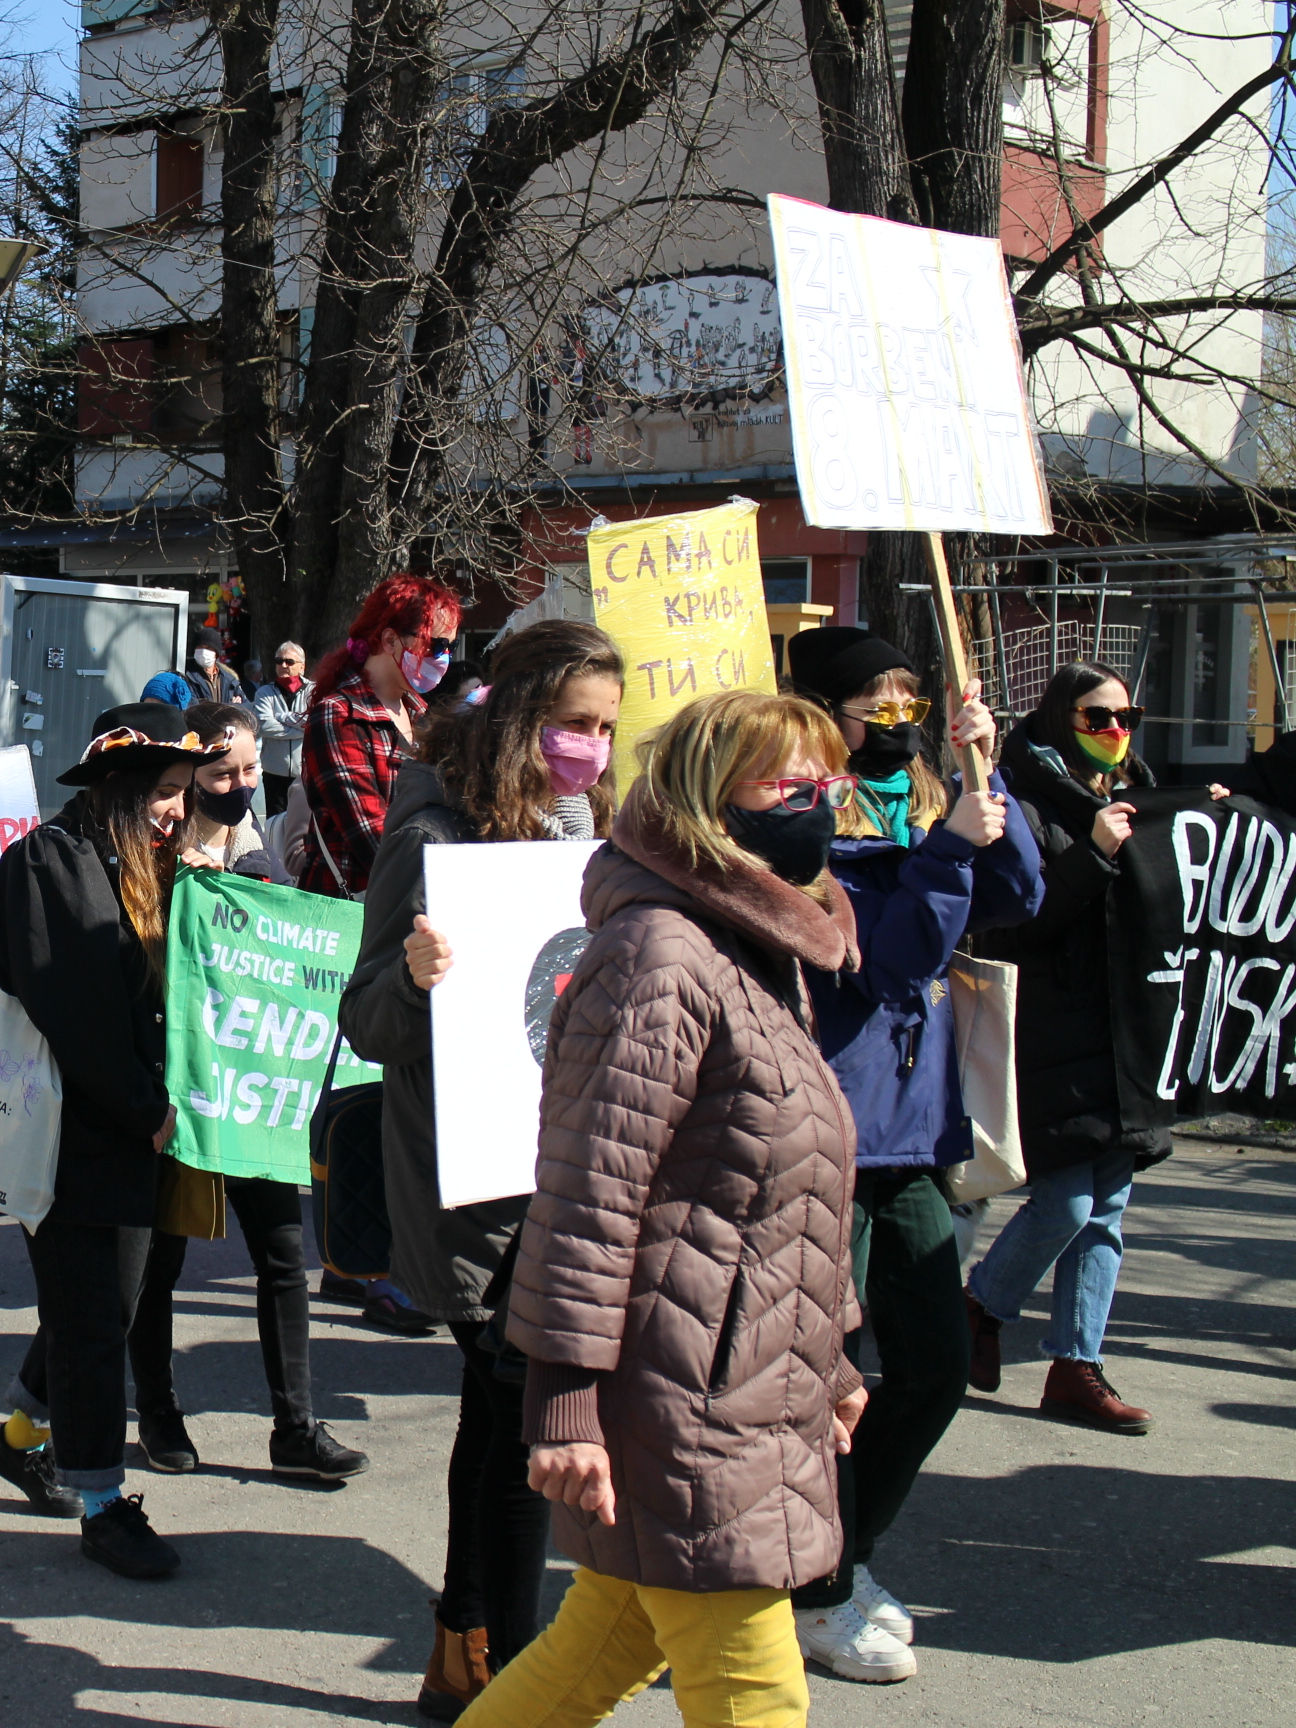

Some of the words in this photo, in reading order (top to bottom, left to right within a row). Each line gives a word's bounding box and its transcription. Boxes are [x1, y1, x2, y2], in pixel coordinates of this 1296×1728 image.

[787, 226, 866, 320] ZA
[765, 414, 784, 426] KULT
[807, 391, 880, 512] 8.
[877, 396, 1025, 521] MART
[722, 526, 750, 566] СИ
[637, 657, 697, 700] ТИ
[715, 648, 747, 690] СИ
[211, 902, 248, 933] NO
[256, 914, 341, 956] CLIMATE
[199, 943, 296, 987] JUSTICE
